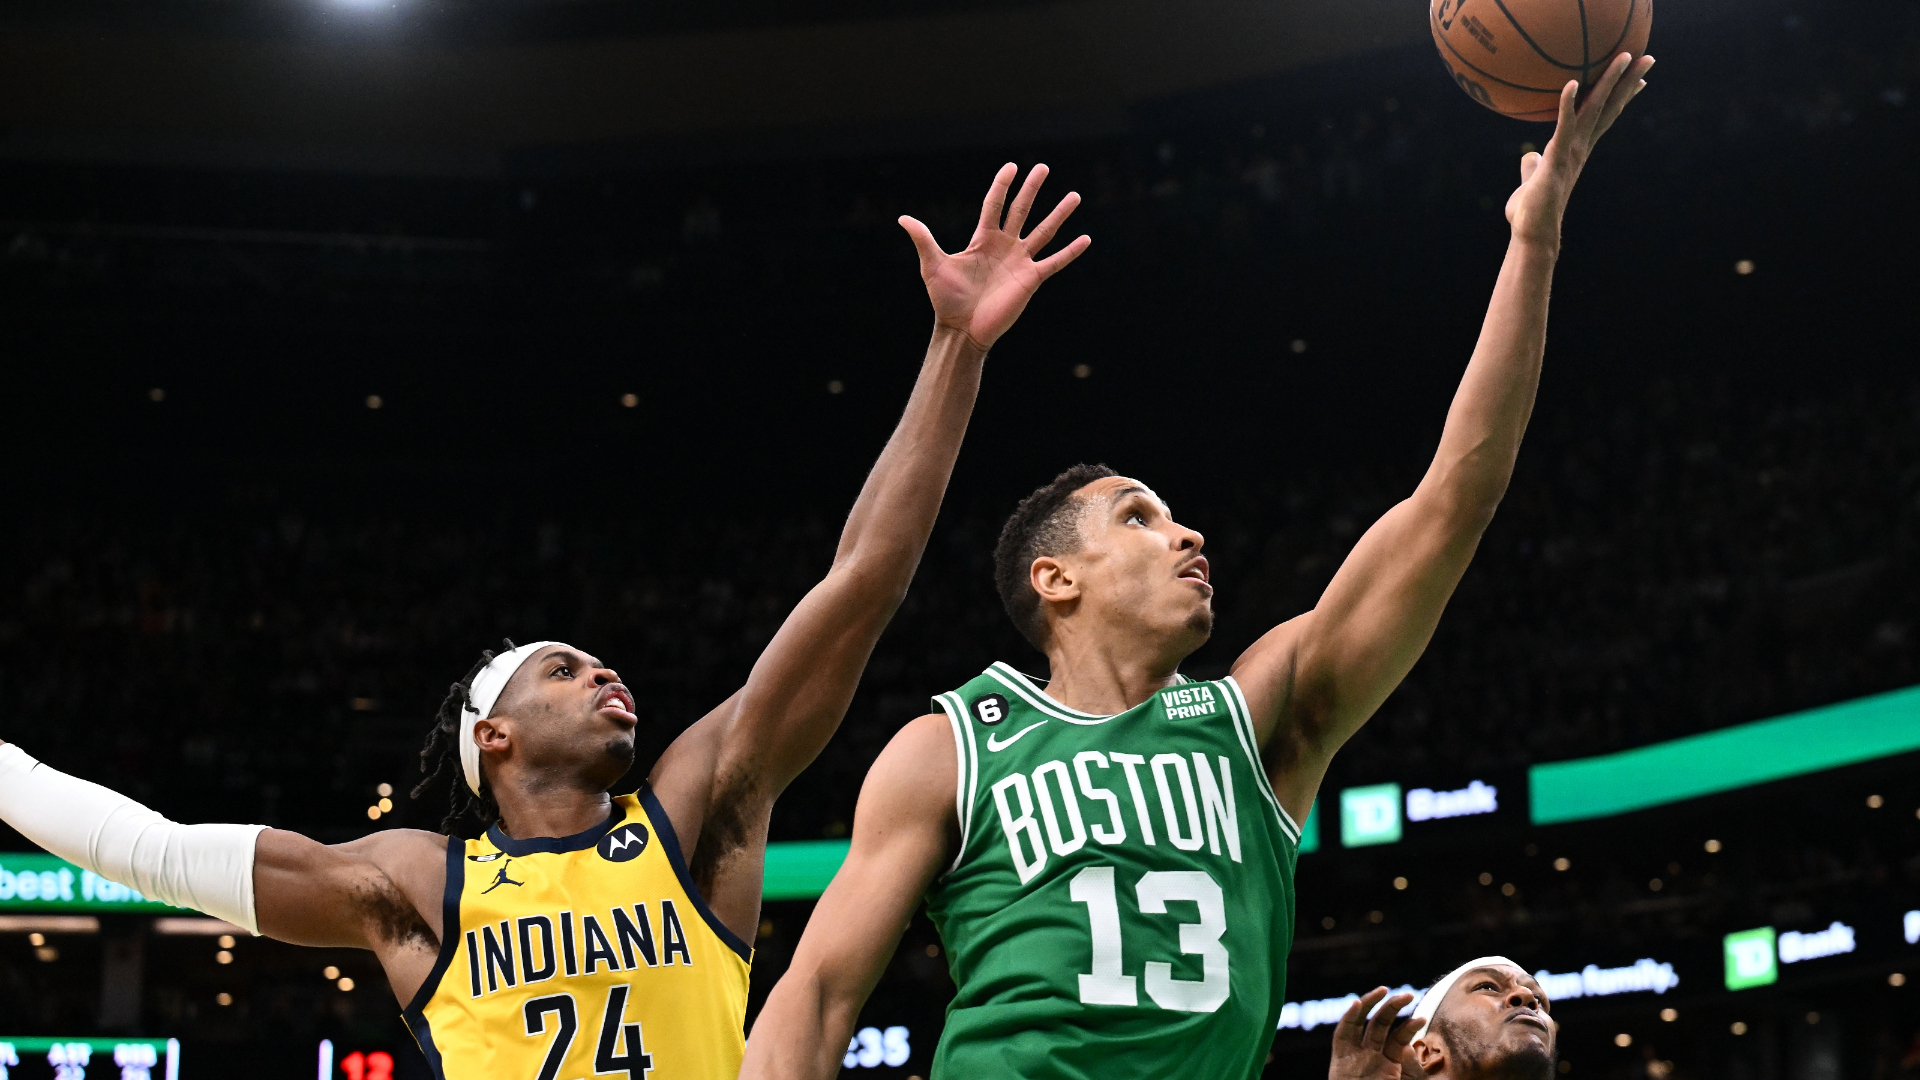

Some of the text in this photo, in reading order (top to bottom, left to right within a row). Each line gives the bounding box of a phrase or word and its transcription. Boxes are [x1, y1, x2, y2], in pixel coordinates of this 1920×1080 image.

[978, 698, 1003, 723] 6
[1161, 687, 1214, 708] VISTA
[1166, 700, 1217, 720] PRINT
[991, 751, 1242, 885] BOSTON
[1344, 779, 1498, 837] TD Bank
[466, 899, 692, 999] INDIANA
[1069, 866, 1230, 1012] 13
[1728, 920, 1856, 977] TD Bank
[1582, 958, 1679, 995] family.
[522, 984, 654, 1080] 24
